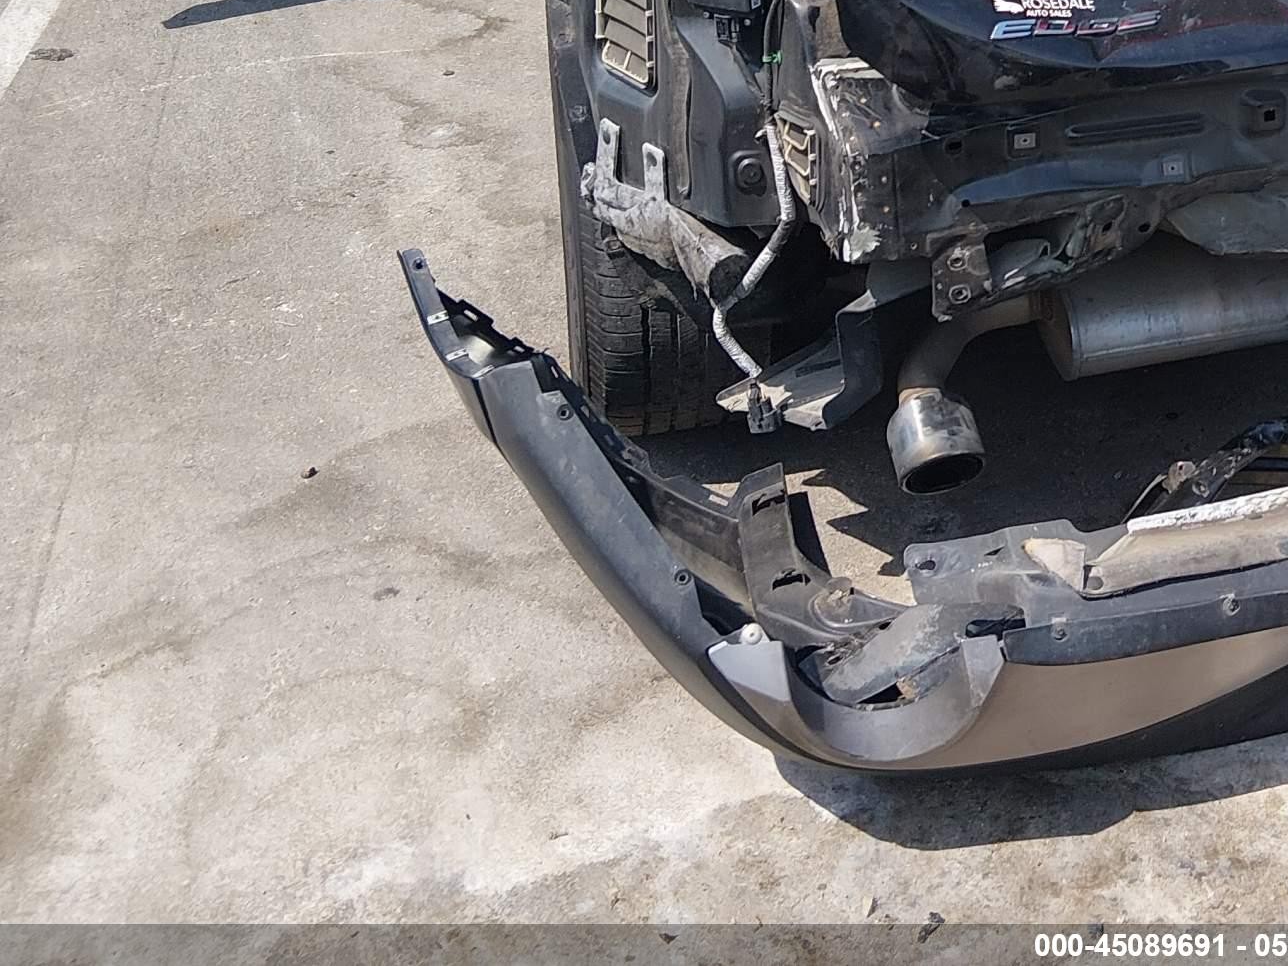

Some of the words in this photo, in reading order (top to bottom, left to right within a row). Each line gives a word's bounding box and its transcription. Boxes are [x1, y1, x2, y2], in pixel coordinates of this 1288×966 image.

[1026, 9, 1048, 18] AUTO
[1049, 9, 1073, 18] SALES
[990, 10, 1164, 40] EDGE
